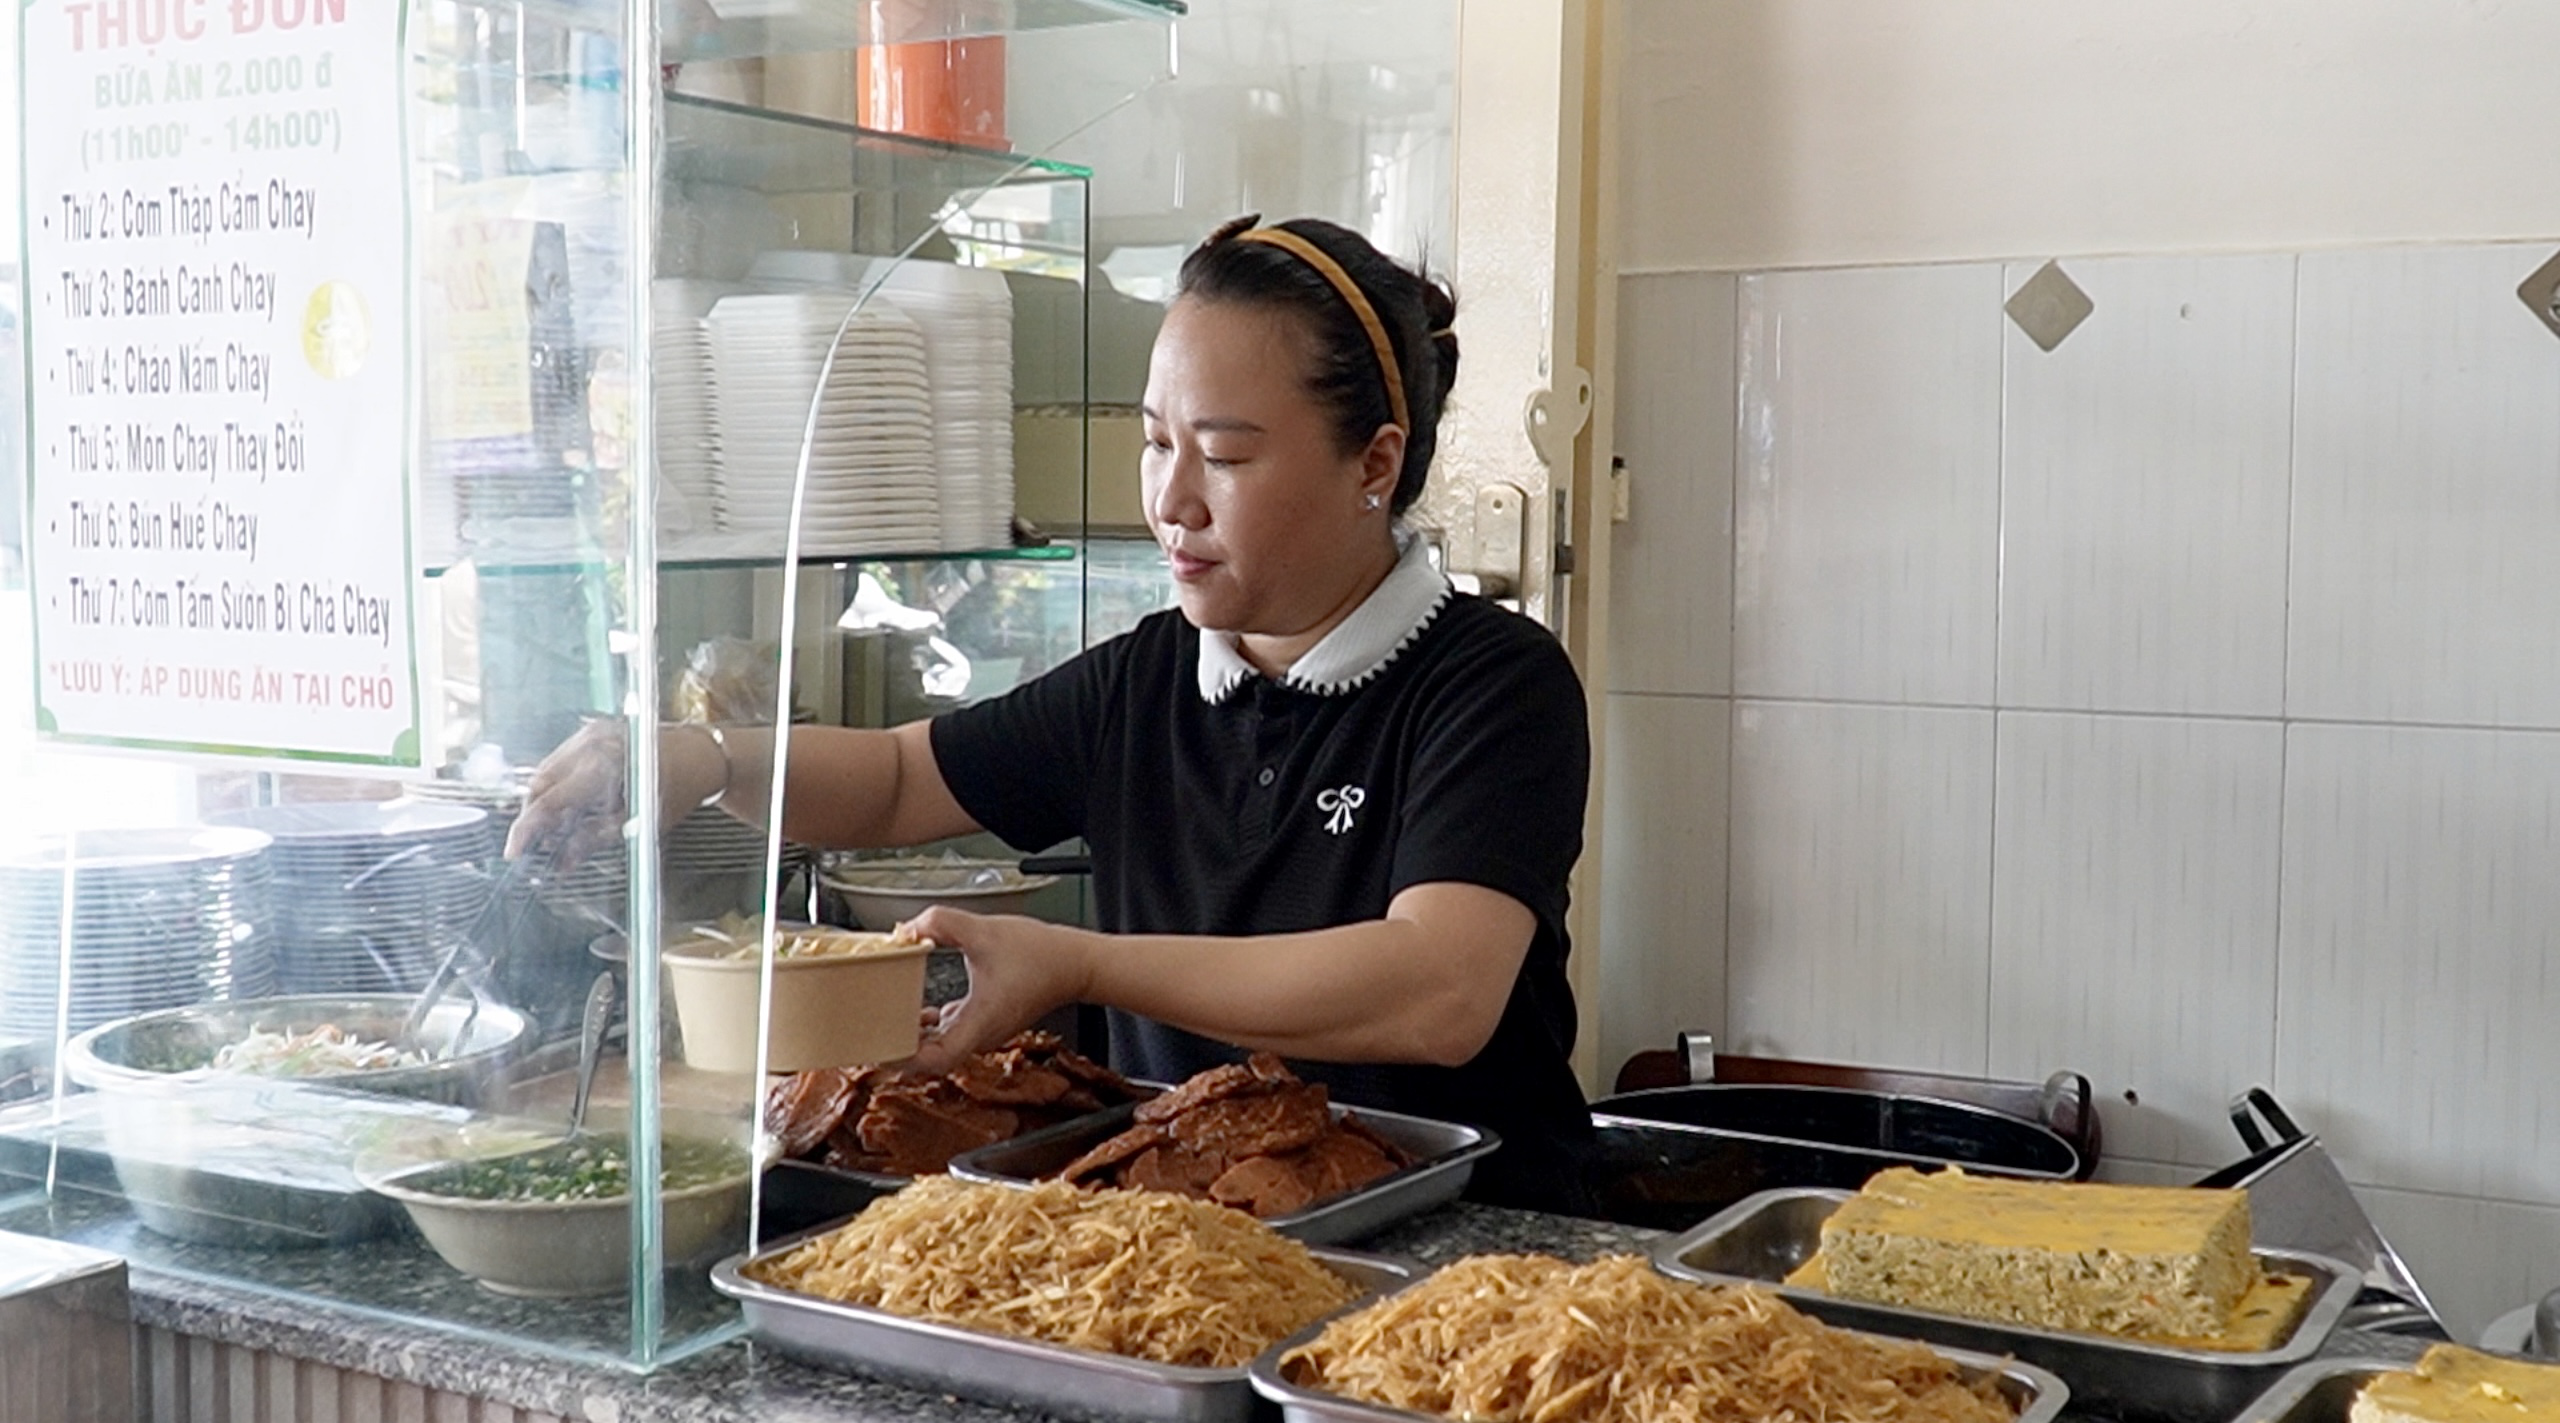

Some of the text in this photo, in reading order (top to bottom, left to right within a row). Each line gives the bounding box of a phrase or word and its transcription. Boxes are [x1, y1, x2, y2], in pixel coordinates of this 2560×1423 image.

[164, 61, 202, 103] ĂN
[215, 54, 303, 98] 2.000
[315, 51, 333, 89] đ
[100, 192, 114, 239] 2:
[122, 189, 161, 238] Cơm
[169, 185, 212, 247] Thập
[220, 170, 259, 233] Cẩm
[268, 178, 315, 239] Chay
[100, 269, 115, 317] 3:
[124, 266, 170, 316] Bánh
[177, 264, 223, 314] Canh
[230, 262, 275, 323] Chay
[101, 347, 117, 393] 4:
[125, 345, 171, 394] Cháo
[179, 338, 218, 393] Nấm
[226, 342, 270, 403] Chay
[104, 424, 120, 471] 5:
[127, 424, 165, 472] Món
[173, 422, 218, 483] Chay
[224, 423, 267, 484] Thay
[275, 410, 304, 472] Đổi
[107, 501, 123, 549] 6:
[129, 501, 162, 549] Bún
[170, 495, 205, 551] Huế
[213, 501, 258, 563] Chay
[109, 578, 124, 625] 7:
[132, 578, 169, 627] Cơm
[176, 573, 213, 628] Tấm
[221, 580, 266, 631] Sườn
[343, 584, 390, 648] Chay
[111, 655, 131, 695] Ý:
[140, 657, 169, 696] ÁP
[178, 667, 241, 705] DỤNG
[251, 665, 282, 703] ĂN
[293, 673, 330, 713] TẠI
